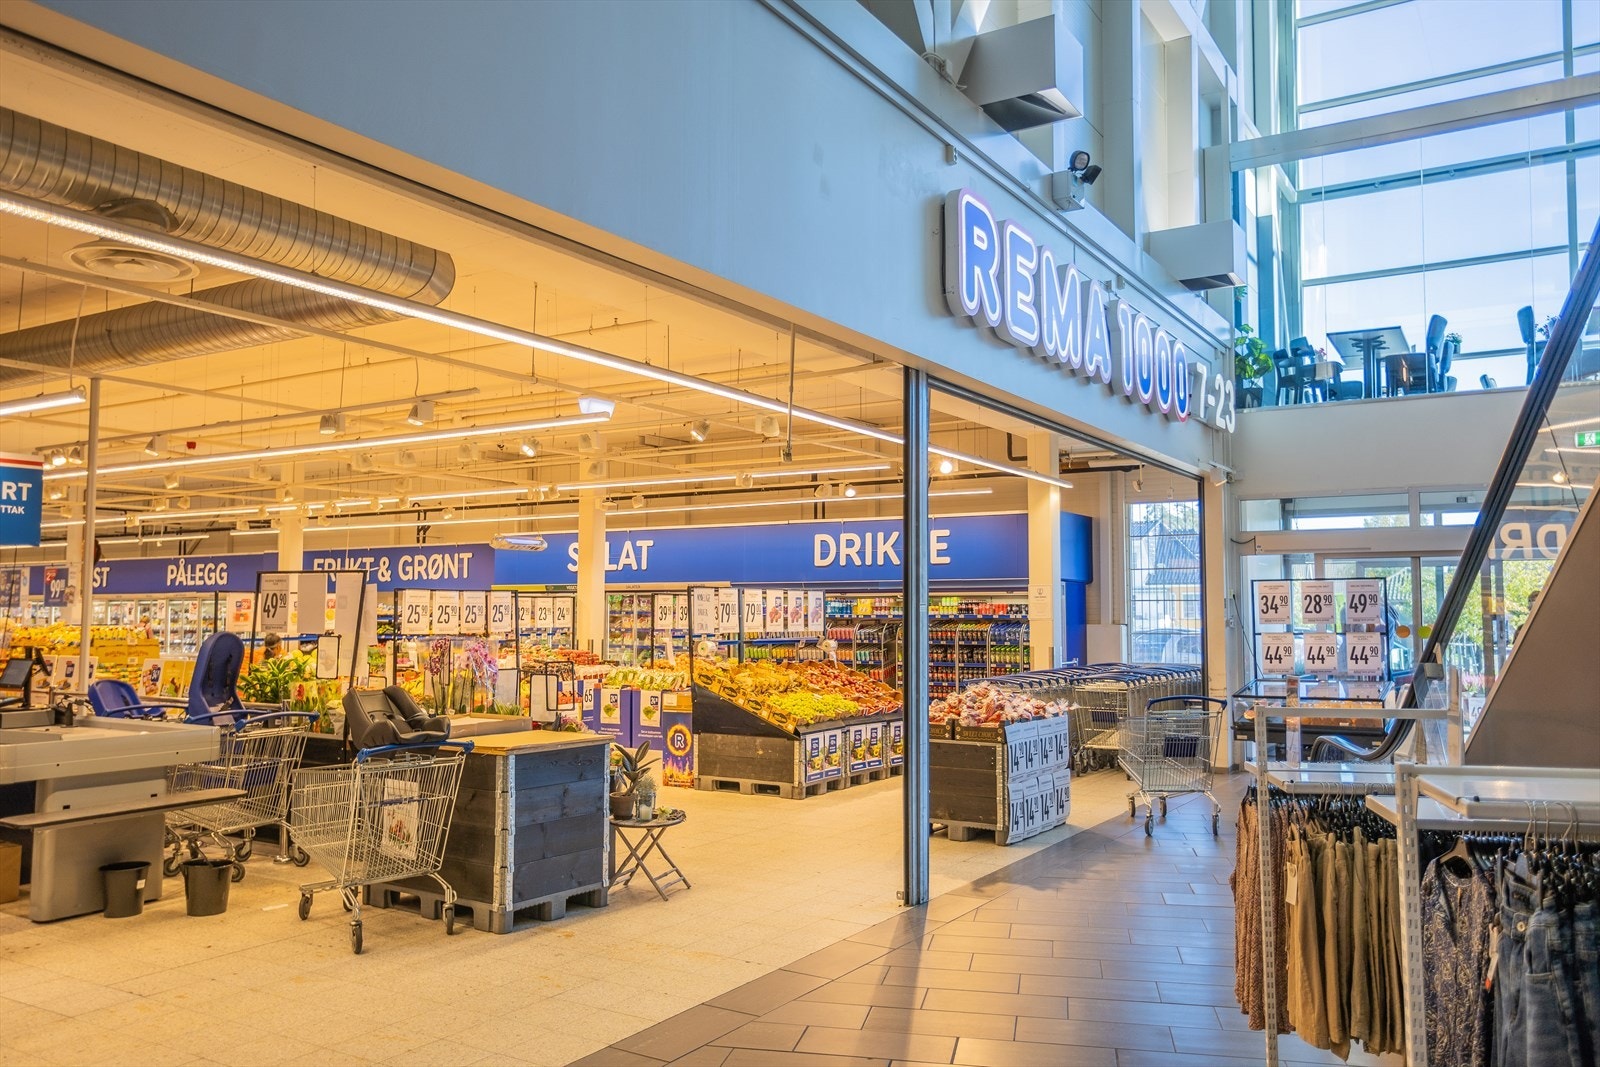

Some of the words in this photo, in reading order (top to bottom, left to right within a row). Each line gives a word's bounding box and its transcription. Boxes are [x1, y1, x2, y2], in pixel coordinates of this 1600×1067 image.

[957, 187, 1112, 385] REMA
[1115, 298, 1189, 422] 1000
[1195, 361, 1236, 434] 7-23
[1, 481, 32, 501] RT
[0, 505, 25, 514] TTAK
[567, 539, 654, 572] SLAT
[814, 529, 951, 566] DRIKE
[92, 567, 110, 587] ST
[166, 558, 228, 586] PÅLEGG
[377, 556, 391, 581] &
[398, 552, 473, 580] GRØNT
[674, 733, 684, 748] R
